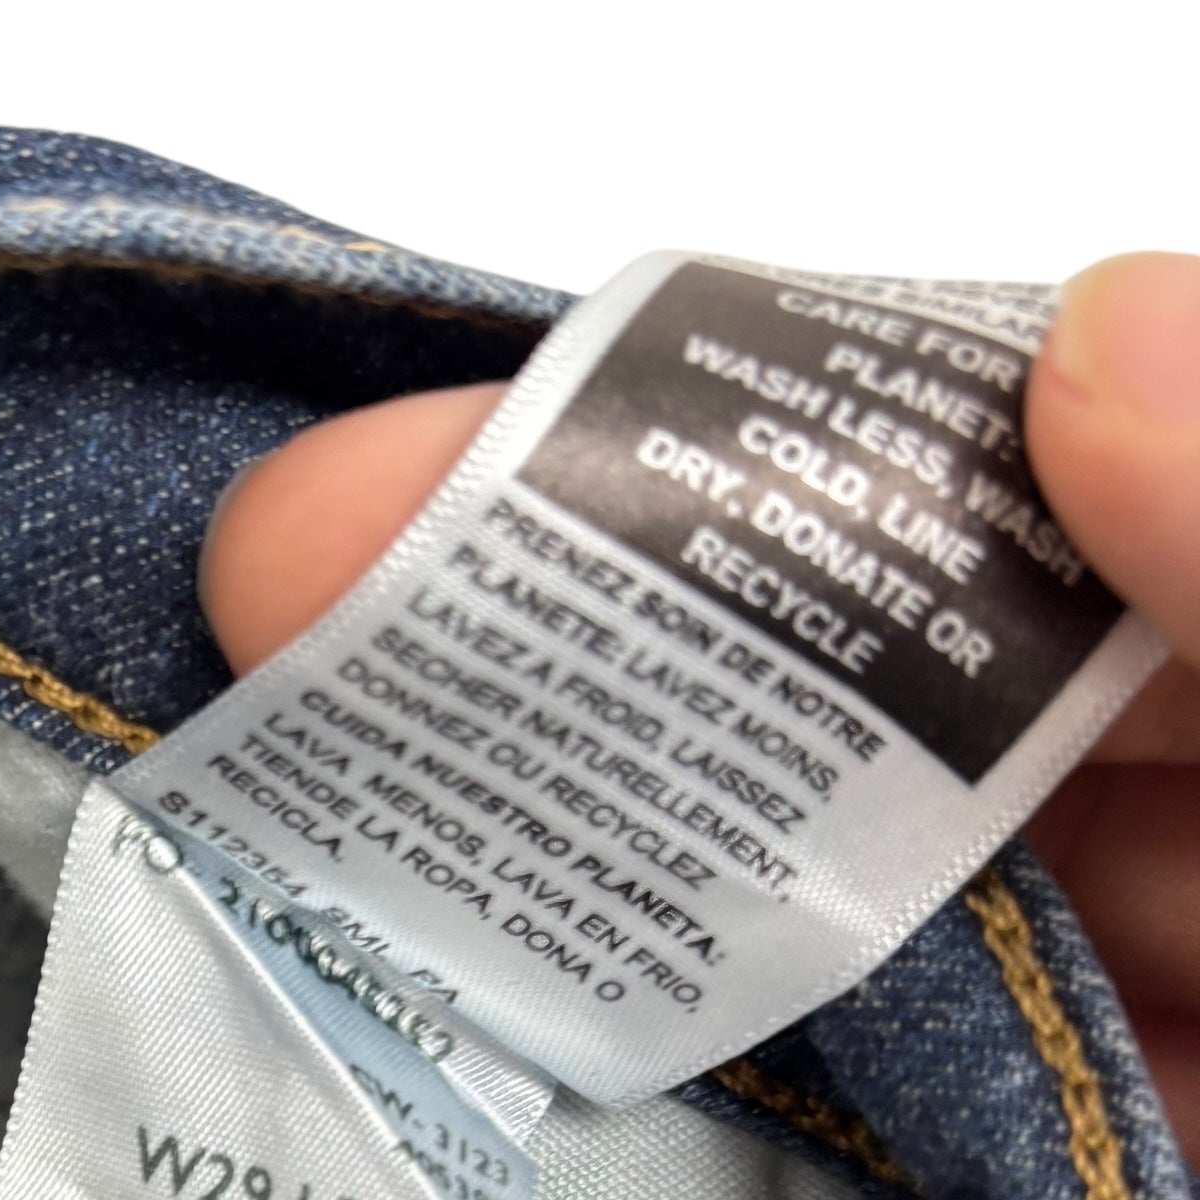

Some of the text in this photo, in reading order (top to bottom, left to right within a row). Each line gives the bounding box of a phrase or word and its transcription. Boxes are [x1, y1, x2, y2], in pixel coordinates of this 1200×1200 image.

[777, 289, 913, 347] CARE
[916, 328, 1024, 391] FOR
[683, 334, 1085, 588] WASH LESS, WASH
[738, 415, 987, 585] COLD, LINE
[370, 625, 516, 717] SECHER
[484, 497, 890, 763] PRENEZ SOIN DE NOTRE
[680, 528, 885, 674] RECYCLE
[751, 491, 935, 629] DONATE
[925, 607, 996, 678] OR
[206, 752, 347, 866] RECICLA.
[337, 657, 497, 772] DONNEZ
[537, 772, 720, 890] RECYCLEZ
[407, 594, 534, 676] LAVEZ
[526, 657, 572, 698] A
[668, 738, 808, 835] LAISSEZ
[626, 644, 734, 727] LAVEZ
[722, 705, 840, 802] MOINS,
[235, 734, 626, 1004] TIENDE LA ROPA, DONA O
[261, 712, 704, 1016] LAVA MENOS, LAVA EN FRIO,
[299, 691, 731, 969] CUIDA NUESTRO PLANETA:
